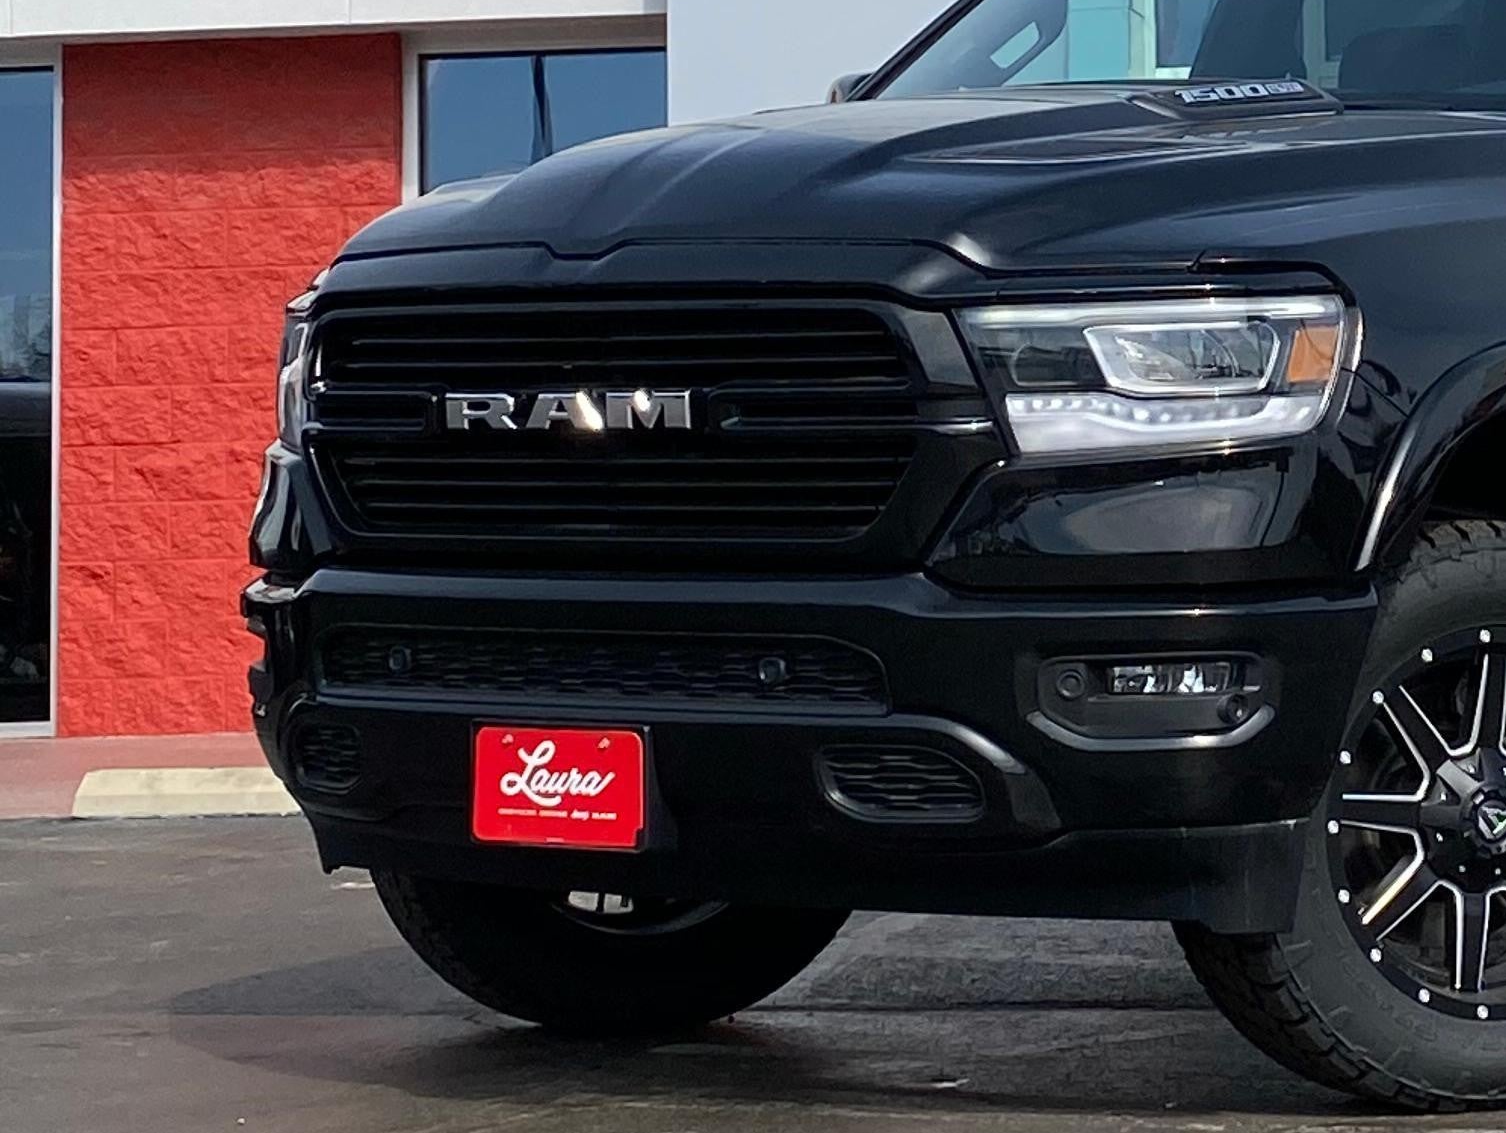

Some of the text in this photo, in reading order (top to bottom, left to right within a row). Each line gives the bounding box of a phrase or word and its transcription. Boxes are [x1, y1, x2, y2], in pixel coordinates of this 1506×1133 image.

[1174, 83, 1269, 104] 1500
[445, 389, 692, 430] RAM
[500, 739, 616, 807] Laura
